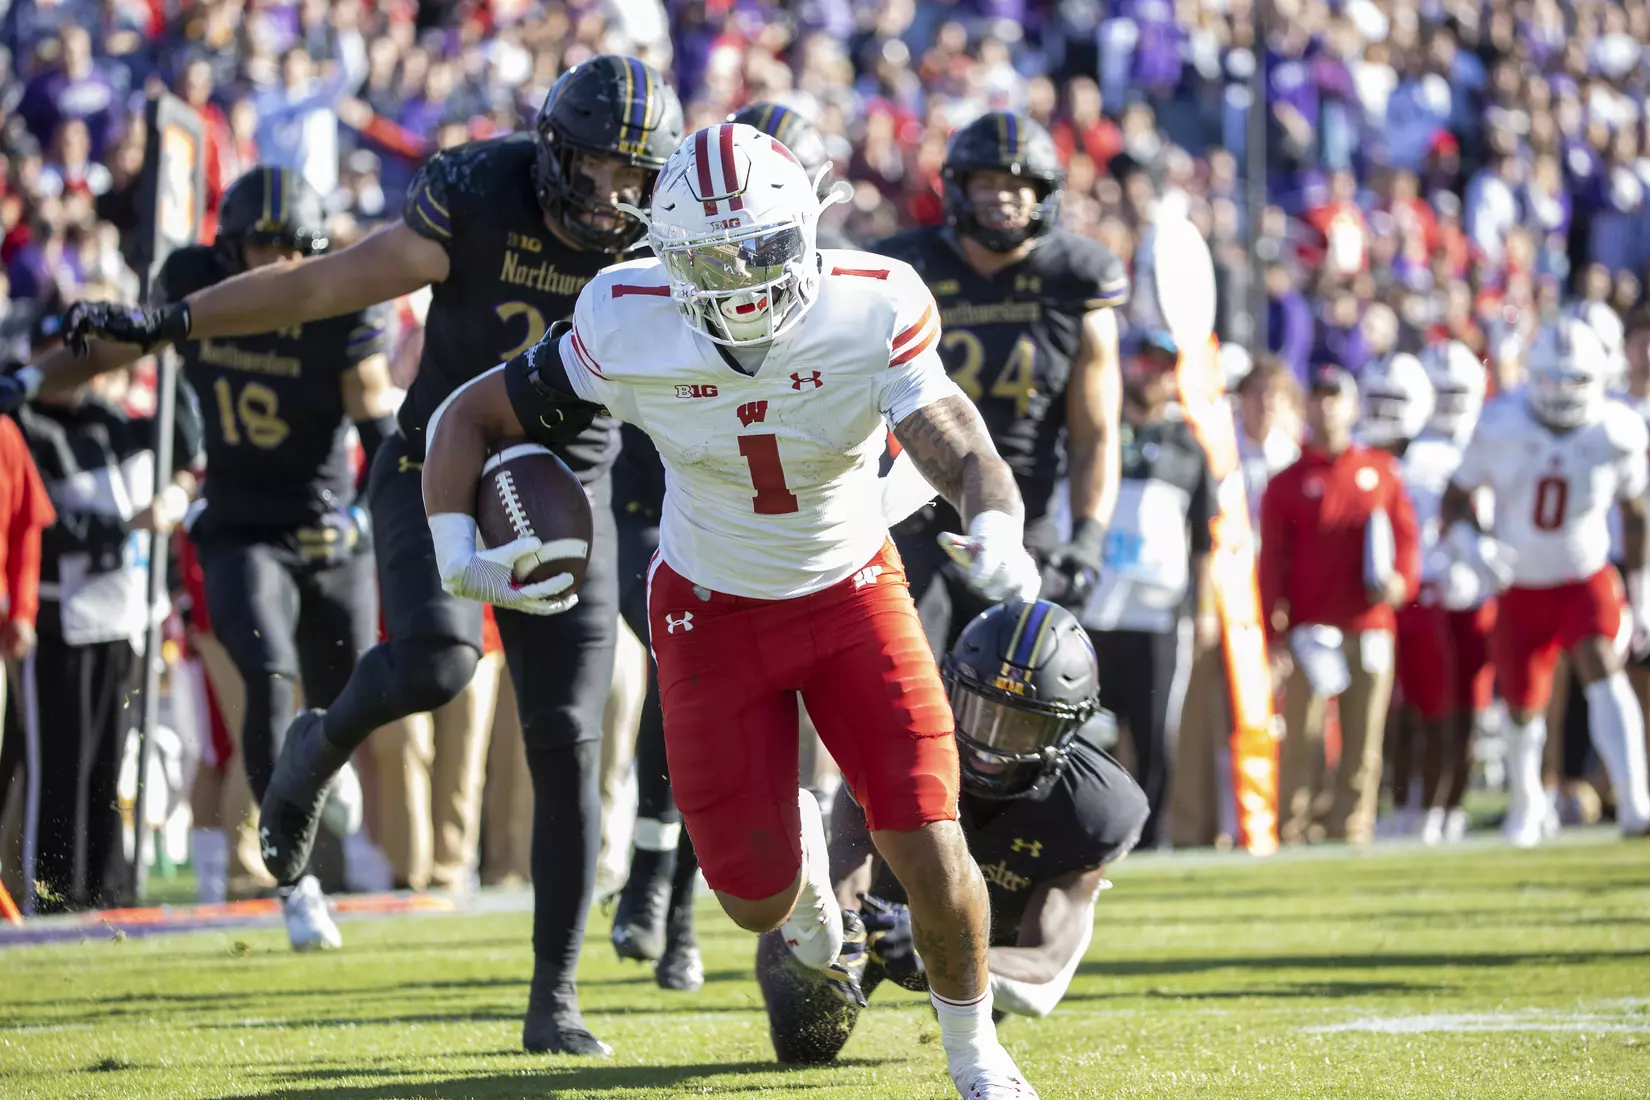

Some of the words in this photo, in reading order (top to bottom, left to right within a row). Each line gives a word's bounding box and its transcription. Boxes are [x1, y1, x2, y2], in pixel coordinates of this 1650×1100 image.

[941, 328, 1038, 417] 34
[213, 375, 290, 448] 18
[737, 400, 768, 428] W
[737, 433, 799, 515] 1
